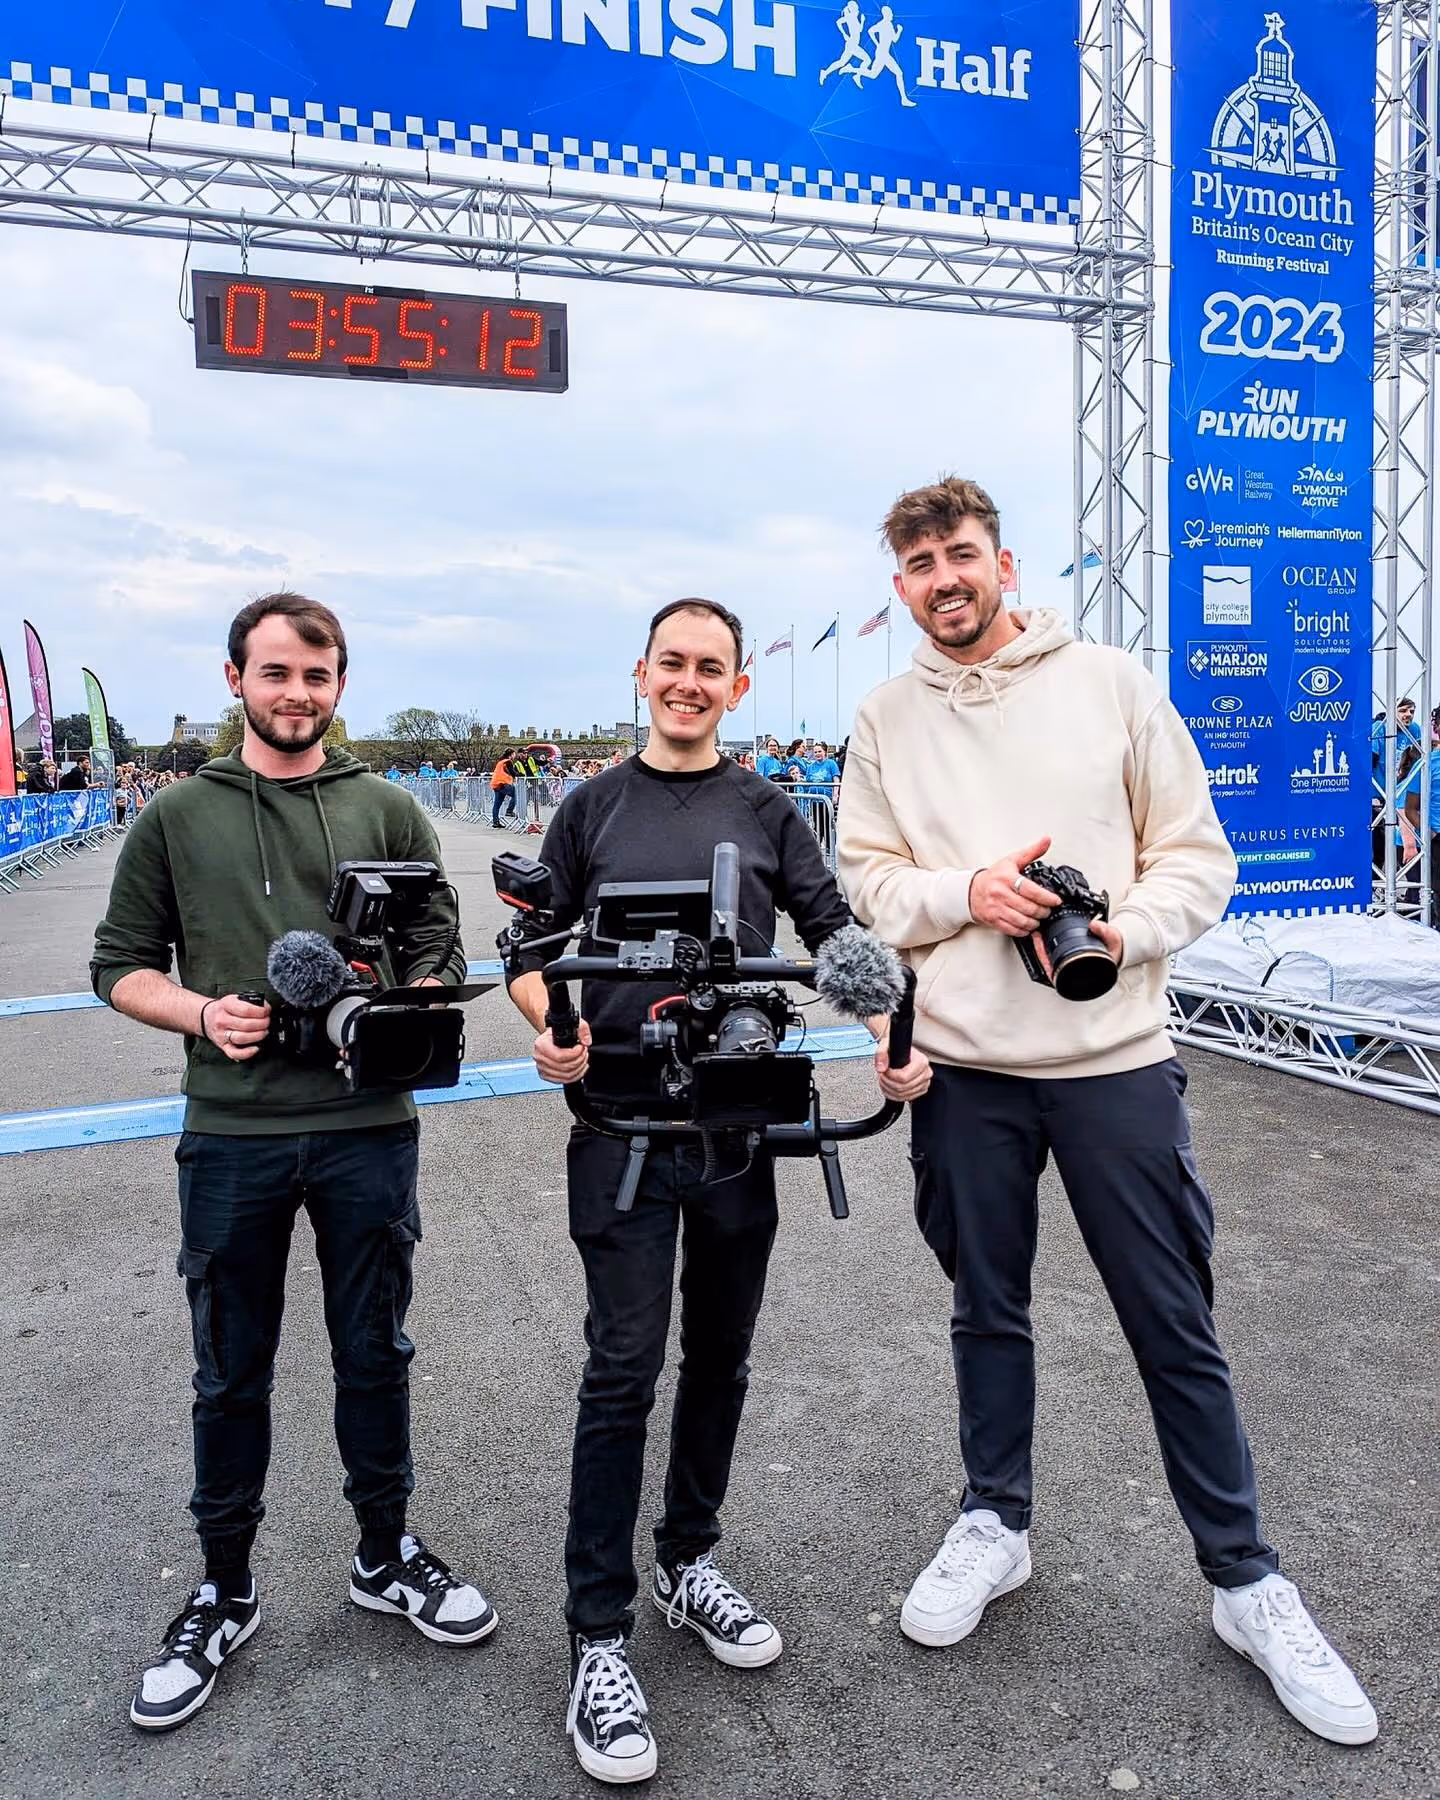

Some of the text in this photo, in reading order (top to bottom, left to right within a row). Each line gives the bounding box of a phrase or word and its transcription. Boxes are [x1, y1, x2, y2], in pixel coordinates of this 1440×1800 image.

[916, 37, 1031, 100] Half
[1191, 170, 1354, 226] Plymouth
[1191, 216, 1355, 257] Britain's Ocean City
[1215, 248, 1330, 275] Running Festival
[1199, 290, 1346, 364] 2024
[1242, 380, 1300, 415] RUN
[1196, 409, 1348, 443] PLYMOUTH
[1186, 464, 1233, 496] GWR
[1245, 470, 1264, 479] Great
[1245, 480, 1273, 491] Western
[1293, 486, 1348, 498] PLYMOUTH
[1245, 490, 1272, 500] Railway
[1302, 497, 1338, 507] ACTIVE
[1208, 522, 1269, 535] Jeremiah's
[1278, 527, 1361, 541] HellermannTyton
[1215, 535, 1263, 549] Journey
[1283, 567, 1356, 586] OCEAN
[1205, 603, 1250, 612] city college
[1205, 611, 1250, 623] plymouth
[1295, 610, 1350, 638] bright
[1316, 647, 1328, 655] legal
[1329, 647, 1350, 655] thinking
[1211, 653, 1267, 665] MARJON
[1211, 667, 1267, 677] UNIVERSITY
[1183, 716, 1231, 730] CROWNE
[1206, 764, 1259, 785] edrok
[1290, 778, 1349, 790] One Plymouth
[1231, 827, 1345, 842] TAURUS EVENTS
[1236, 852, 1310, 863] EVENT ORGANISER
